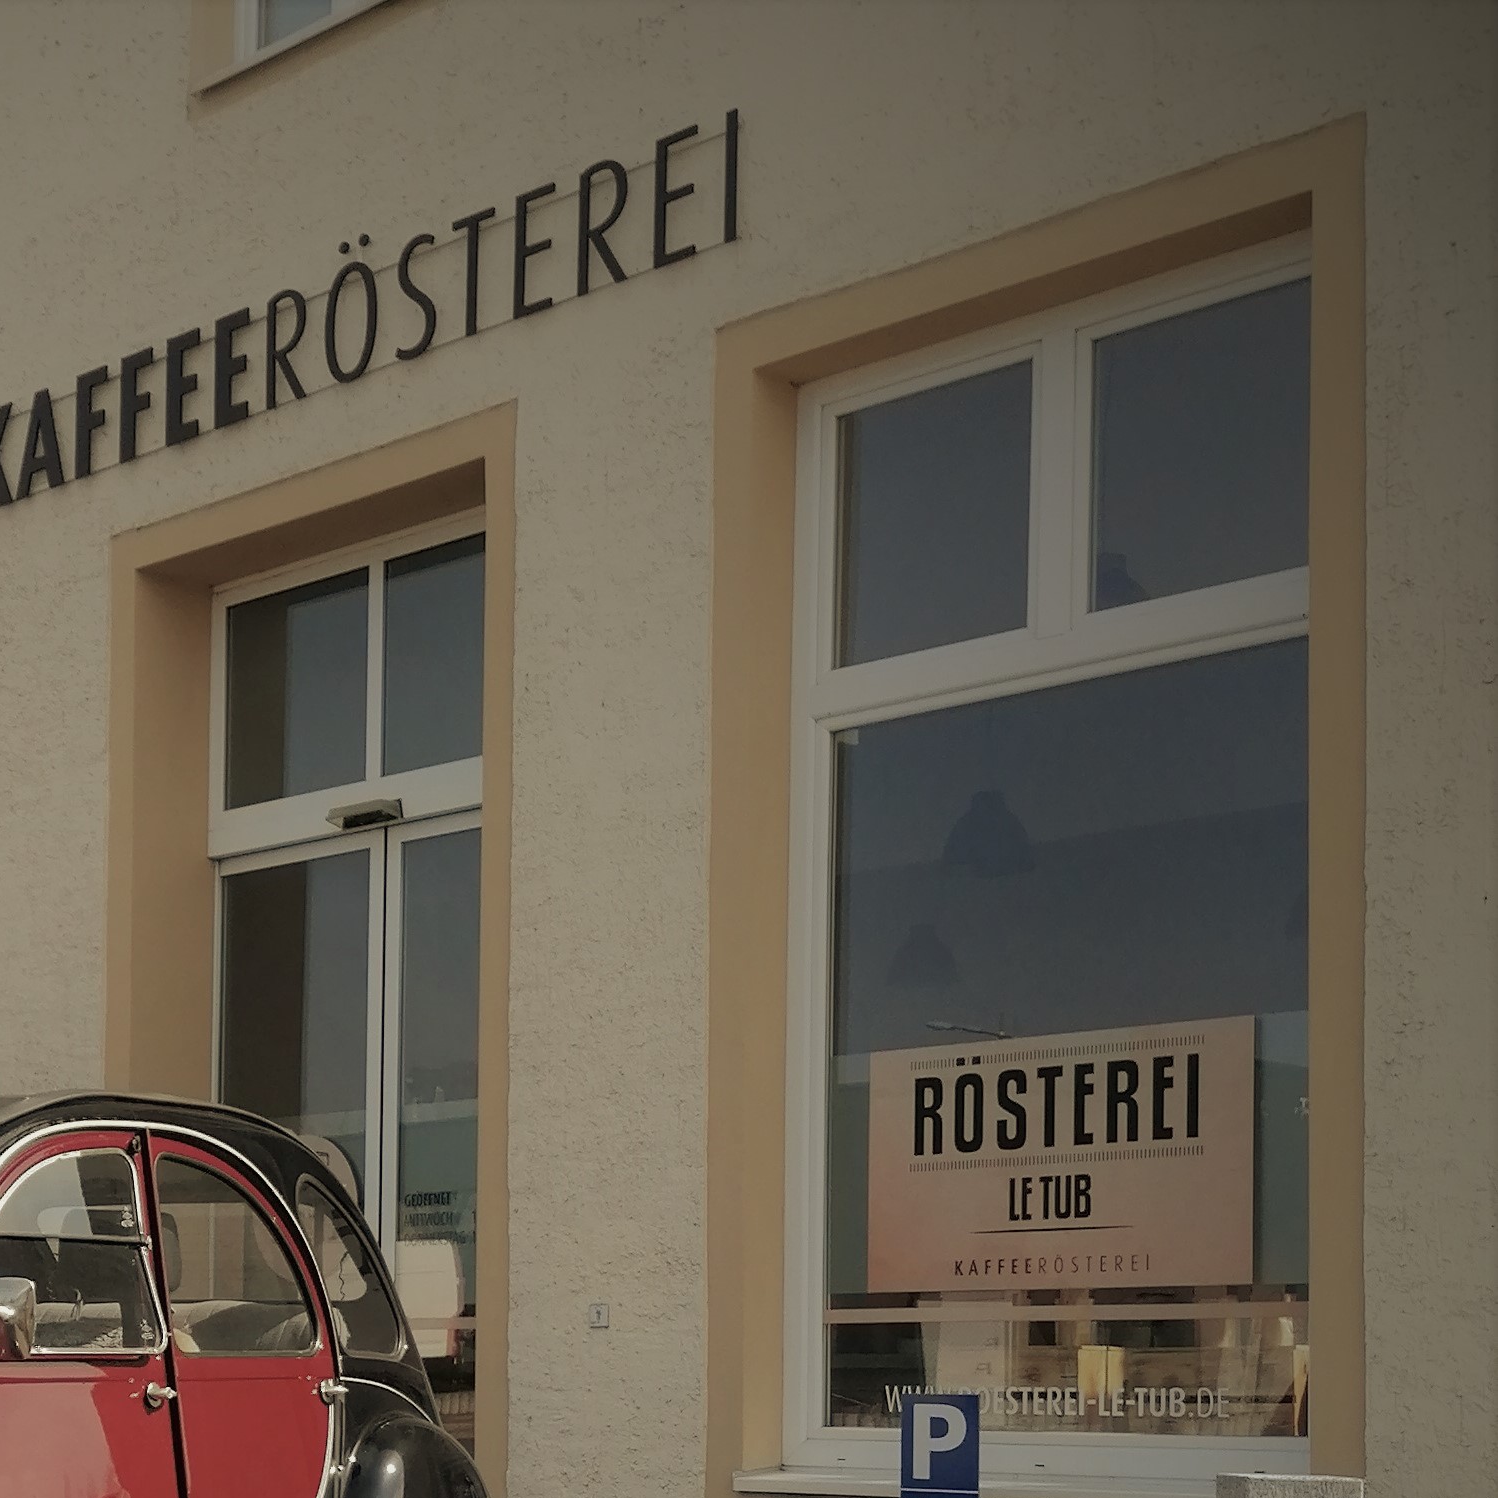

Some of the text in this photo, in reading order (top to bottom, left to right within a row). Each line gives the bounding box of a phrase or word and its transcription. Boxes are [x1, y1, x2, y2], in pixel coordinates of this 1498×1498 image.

[913, 1053, 1200, 1156] RÖSTEREI
[1008, 1173, 1092, 1222] LE TUB
[955, 1253, 1150, 1277] KAFFEERÖSTEREI
[912, 1403, 967, 1480] P
